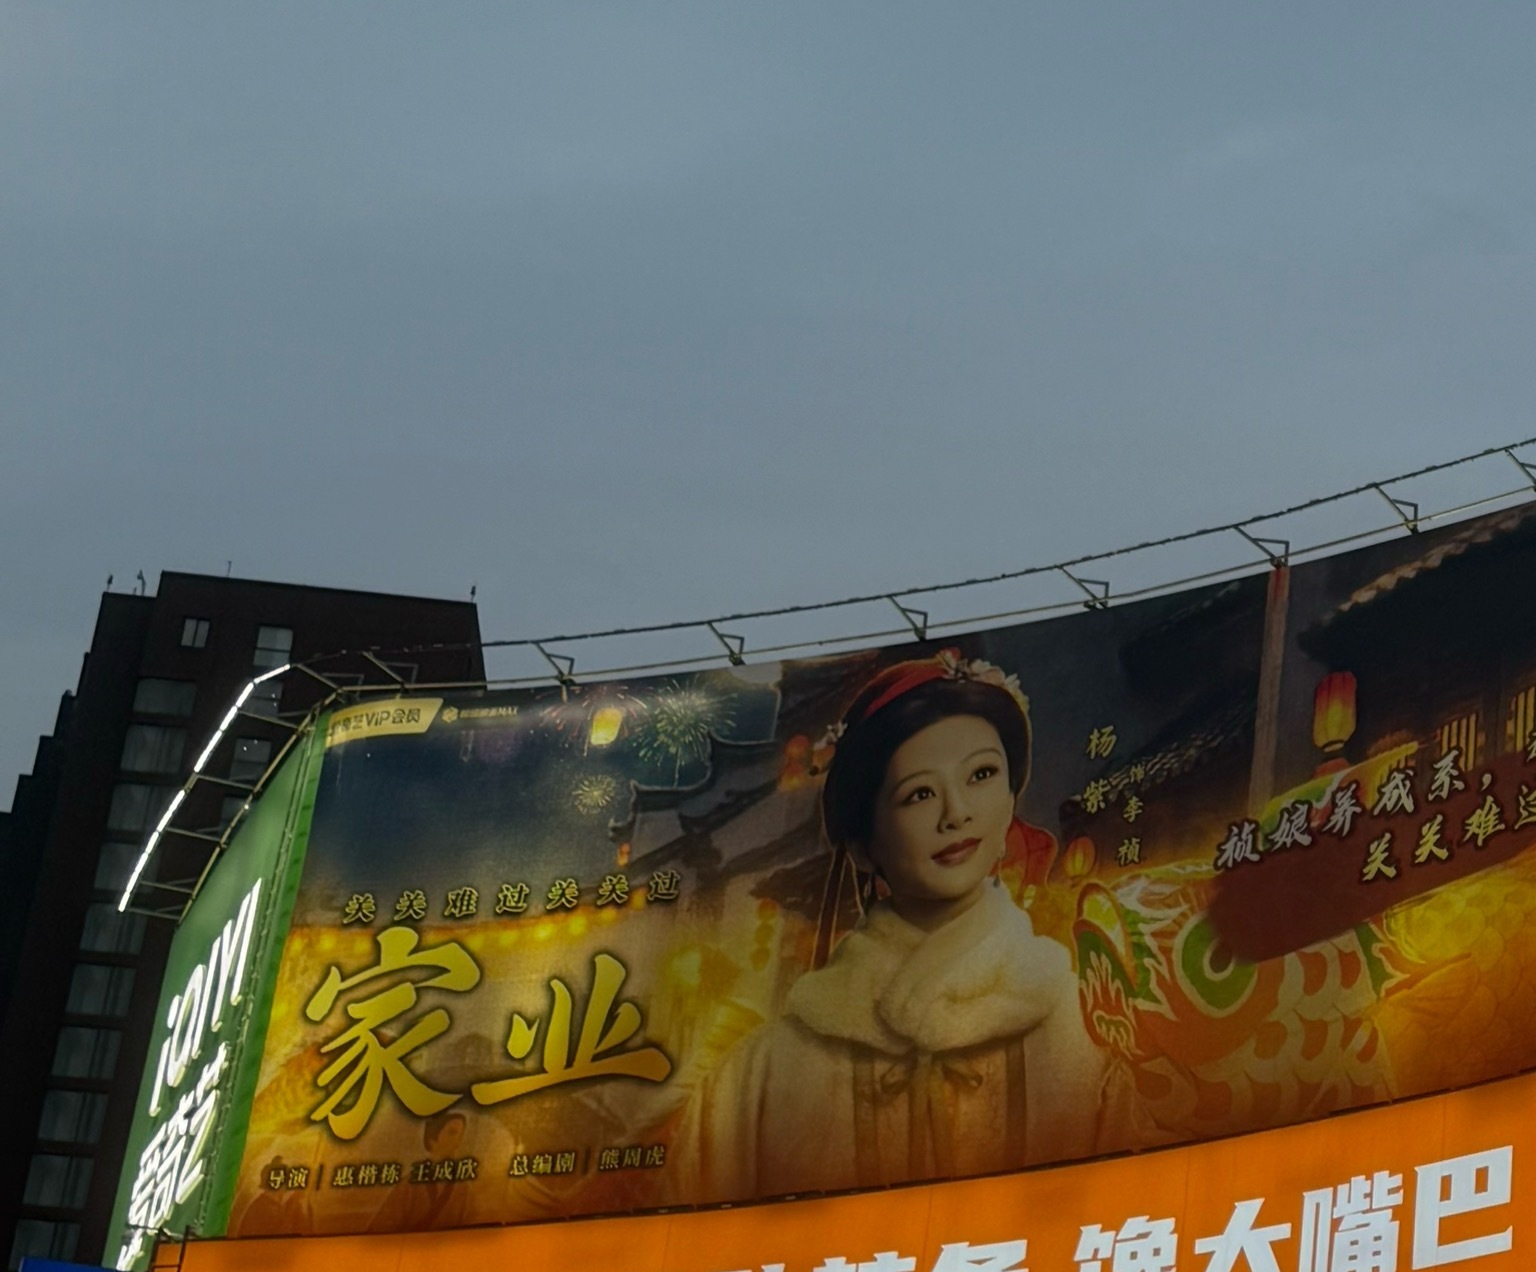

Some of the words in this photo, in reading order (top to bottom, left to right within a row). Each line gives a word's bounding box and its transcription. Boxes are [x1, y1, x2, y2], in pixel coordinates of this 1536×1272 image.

[1086, 725, 1117, 814] 杨紫
[305, 926, 672, 1140] 家业
[267, 1167, 308, 1190] 导演
[332, 1162, 400, 1187] 惠楷栋
[410, 1157, 478, 1184] 王成欣
[509, 1150, 576, 1177] 总编剧
[600, 1145, 666, 1170] 熊周虎
